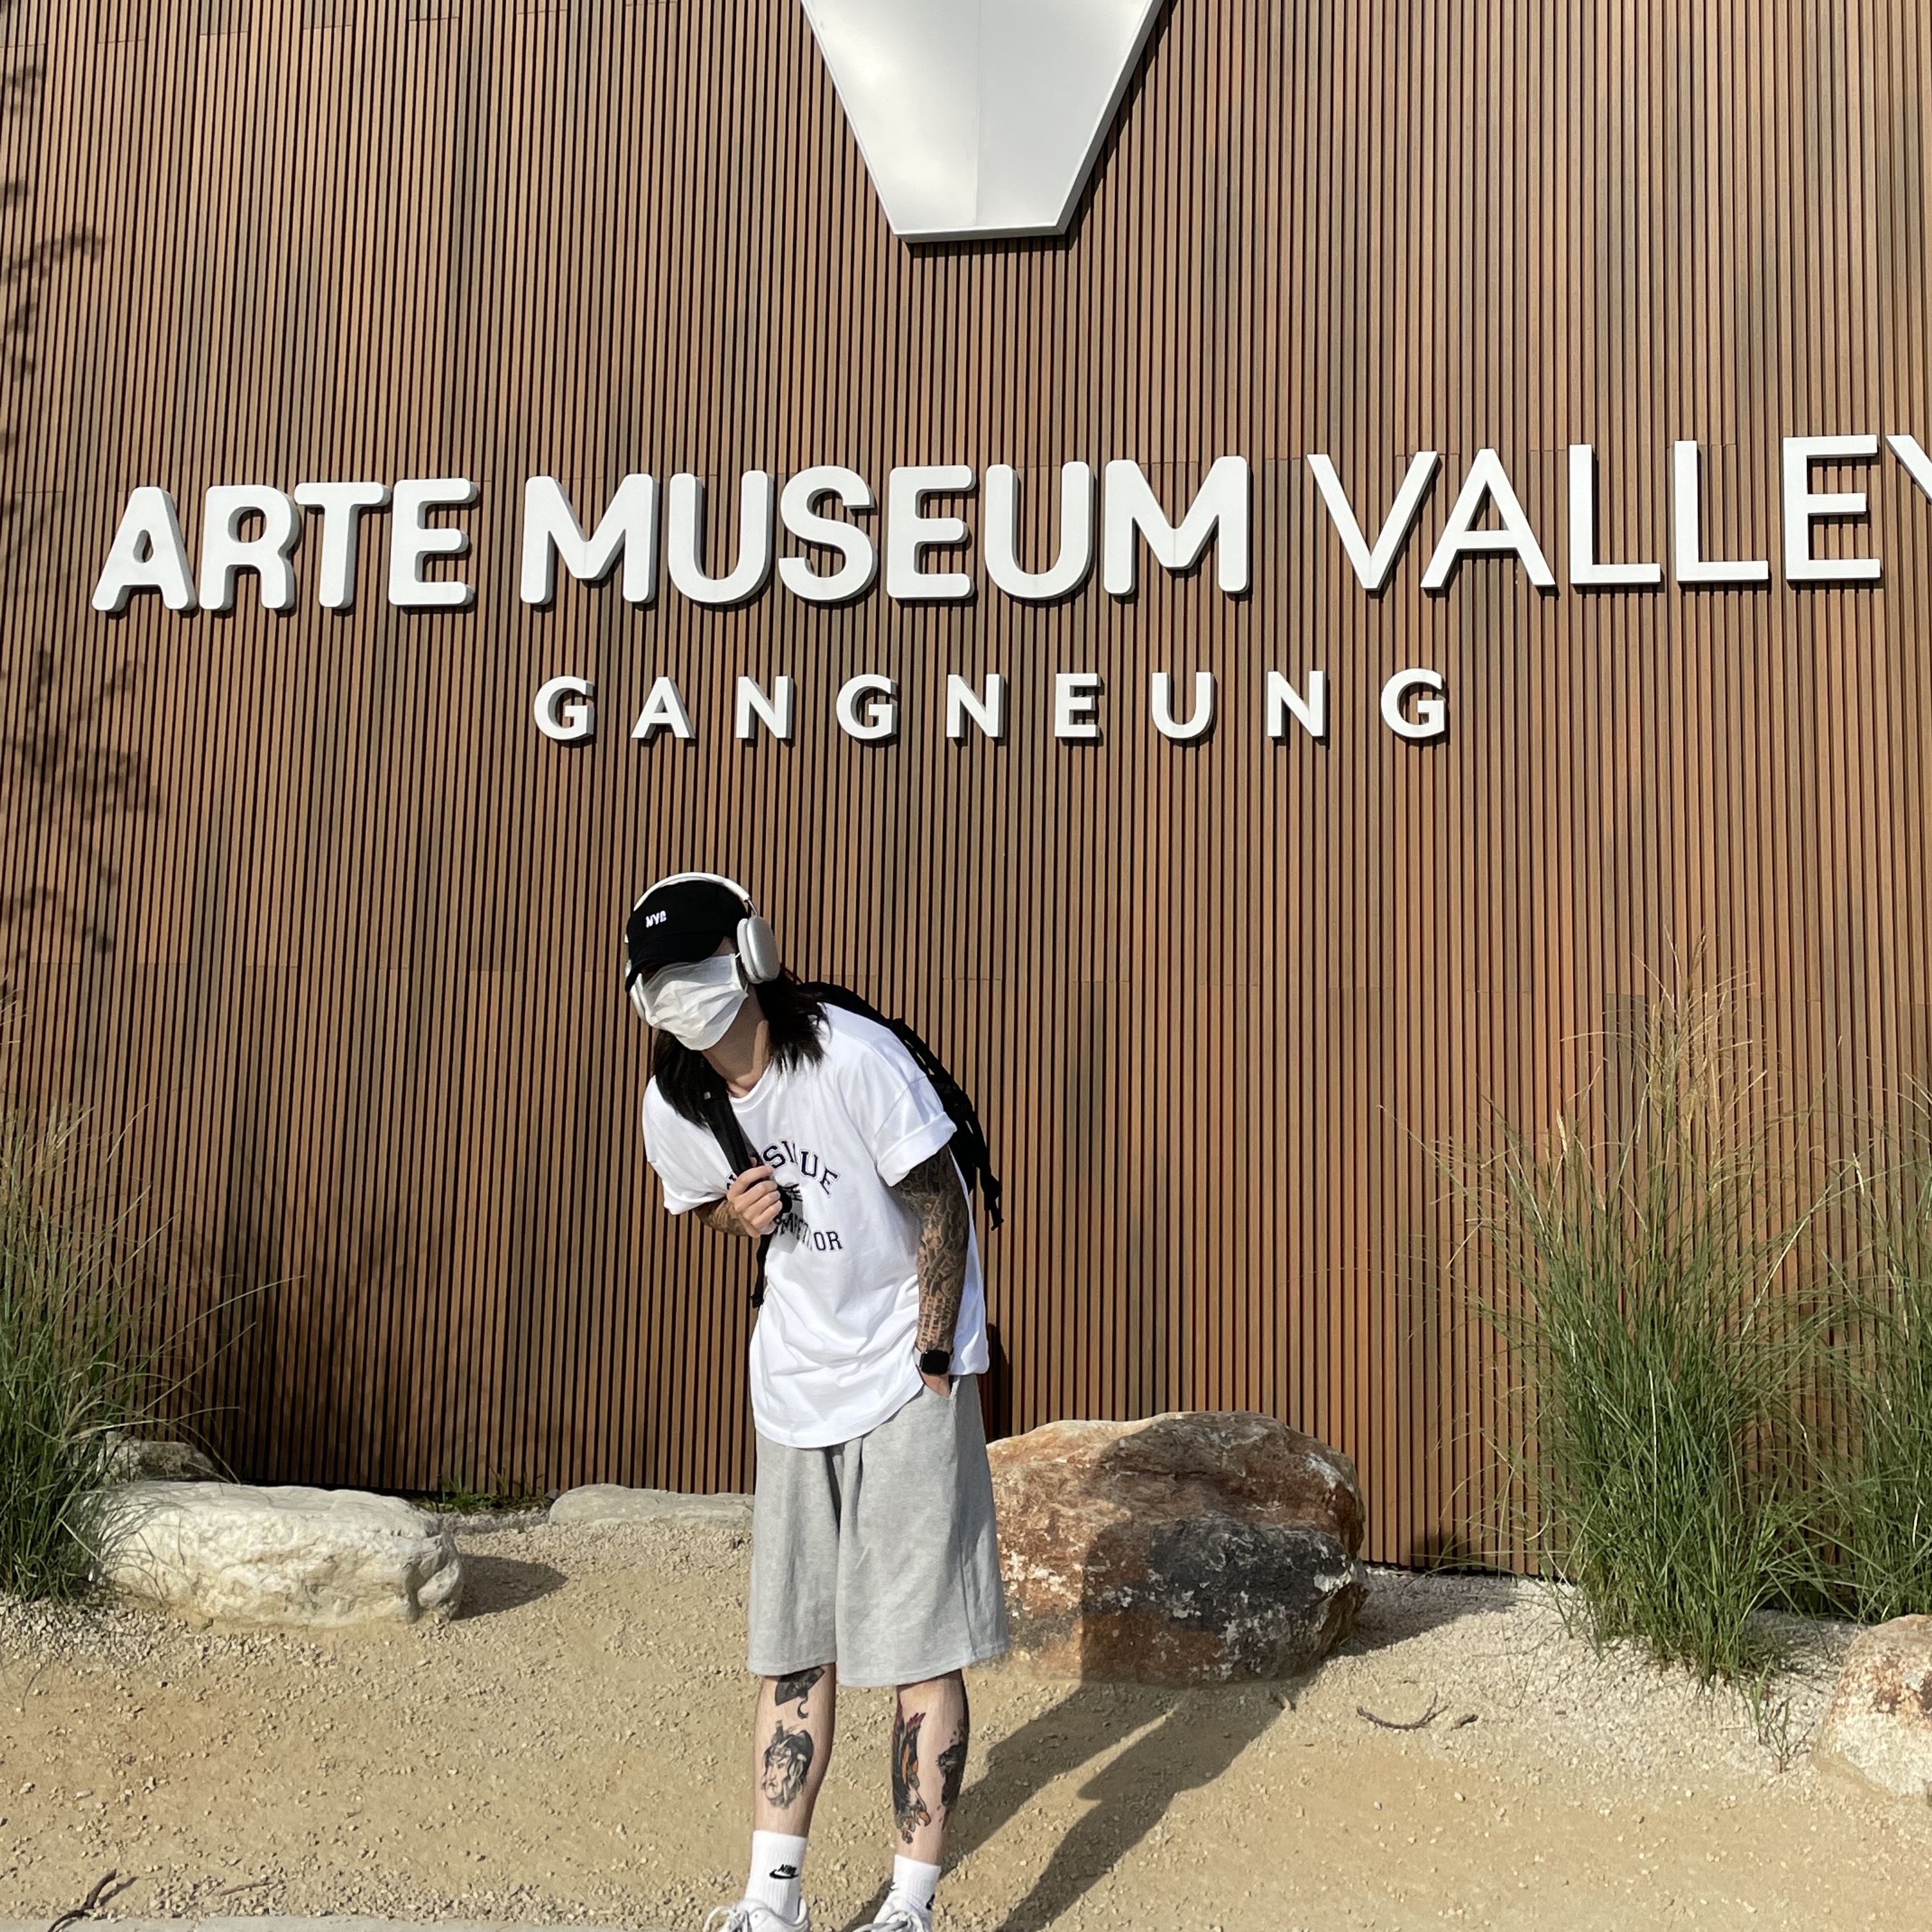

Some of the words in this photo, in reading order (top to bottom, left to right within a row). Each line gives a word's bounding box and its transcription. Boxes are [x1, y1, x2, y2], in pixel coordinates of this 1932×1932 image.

[91, 477, 480, 612] ARTE
[520, 455, 1250, 604] MUSEUM
[533, 668, 1446, 740] GANGNEUNG
